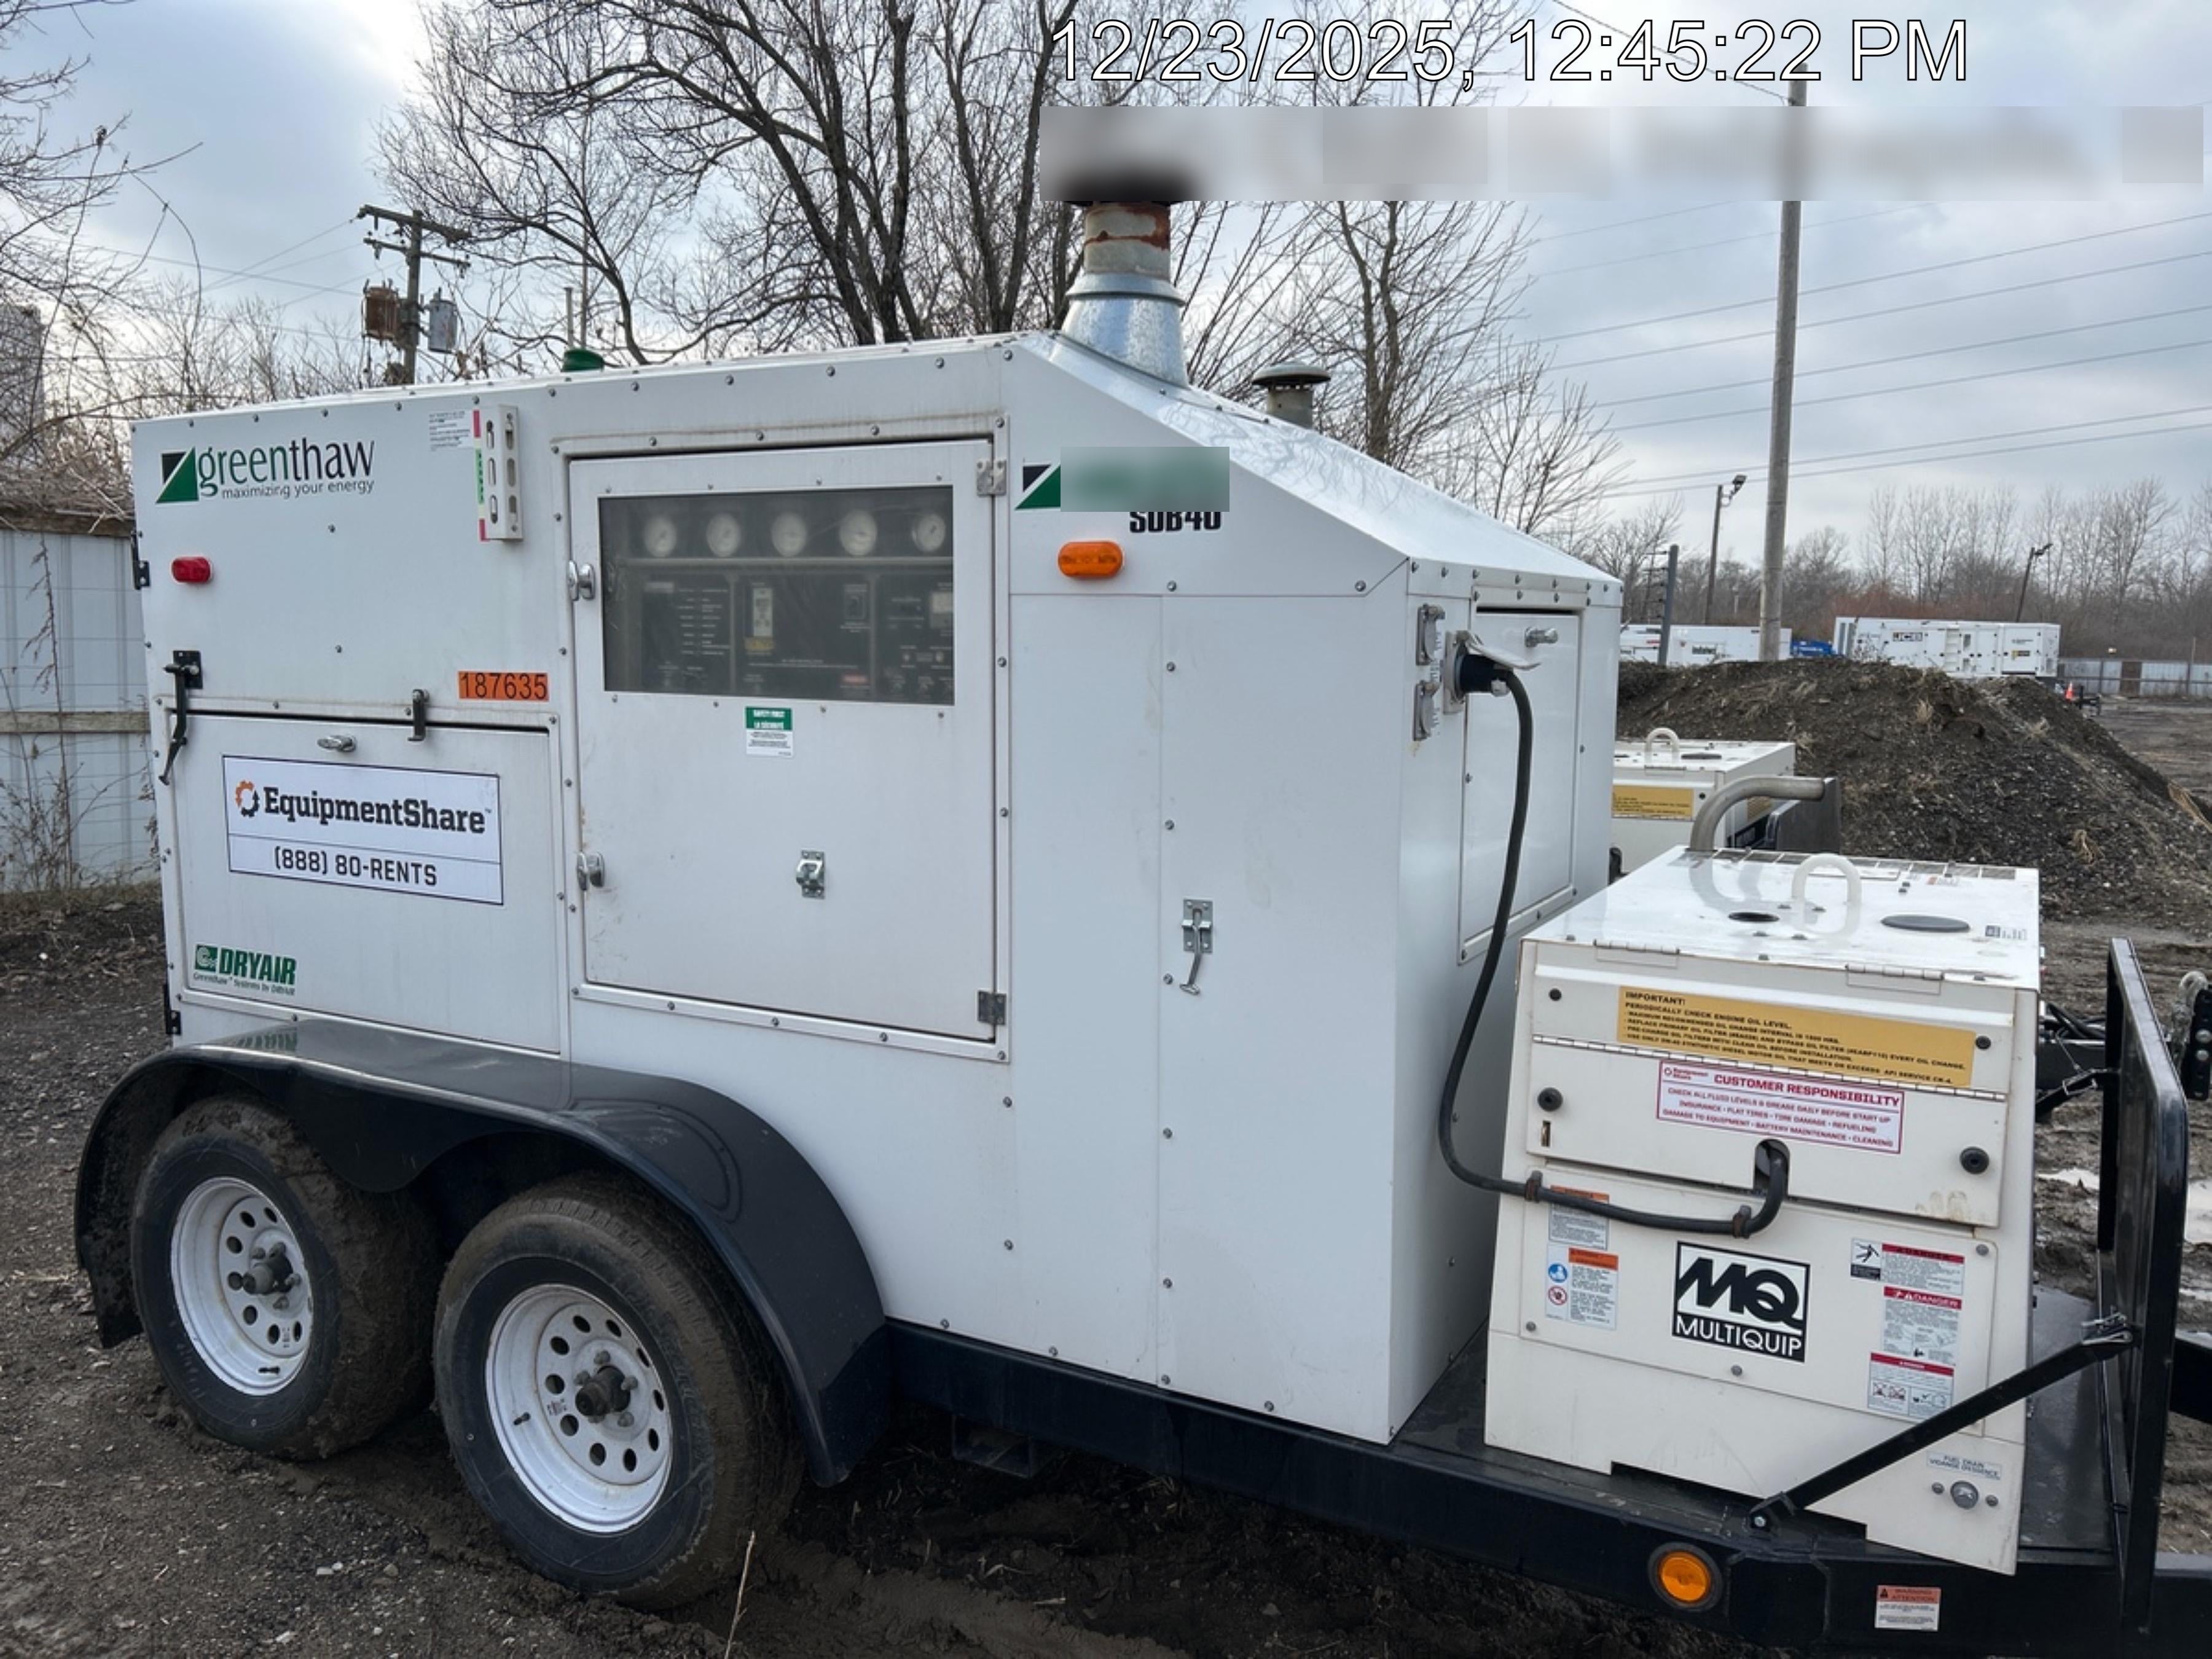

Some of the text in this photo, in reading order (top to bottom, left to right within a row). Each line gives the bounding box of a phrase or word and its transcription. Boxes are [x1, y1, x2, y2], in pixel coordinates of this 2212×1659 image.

[198, 437, 375, 497] greenthaw
[222, 480, 375, 499] maximizing your energy
[461, 672, 547, 699] 187635
[274, 845, 437, 886] (888) 80-RENTS
[219, 948, 296, 985] DRYAIR
[1625, 1002, 1682, 1014] PERIODICALLY
[1684, 1010, 1711, 1019] CHECK
[1714, 1014, 1745, 1022] ENGINE
[1662, 1016, 1714, 1027] RECOMMENDED
[1728, 1024, 1757, 1033] CHANGE
[1760, 1029, 1794, 1038] INTERVAL
[1628, 1018, 1658, 1026] REPLACE
[1658, 1021, 1689, 1031] PRIMARY
[1889, 1053, 1915, 1062] EVERY
[1714, 1075, 1900, 1105] CUSTOMER RESPONSIBILITY
[1898, 1071, 1931, 1081] SERVICE
[1668, 1087, 1691, 1096] CHECK
[1708, 1093, 1730, 1102] FLUID
[1730, 1096, 1757, 1105] LEVELS
[1765, 1100, 1795, 1111] GREASE
[1797, 1105, 1819, 1114] DAILY
[1821, 1108, 1850, 1118] BEFORE
[1852, 1113, 1877, 1122] START
[1679, 1100, 1720, 1112] INSURANCE
[1746, 1110, 1768, 1119] TIRES
[1794, 1116, 1826, 1126] DAMAGE
[1832, 1121, 1877, 1134] REFUELING
[1662, 1108, 1693, 1119] DAMAGE
[1706, 1115, 1751, 1126] EQUIPMENT
[1755, 1122, 1788, 1132] BATTERY
[1790, 1126, 1846, 1141] MAINTENANCE
[1853, 1135, 1893, 1147] CLEANING
[1677, 1257, 1803, 1332] MQ
[1676, 1314, 1802, 1357] MULTIQUIP
